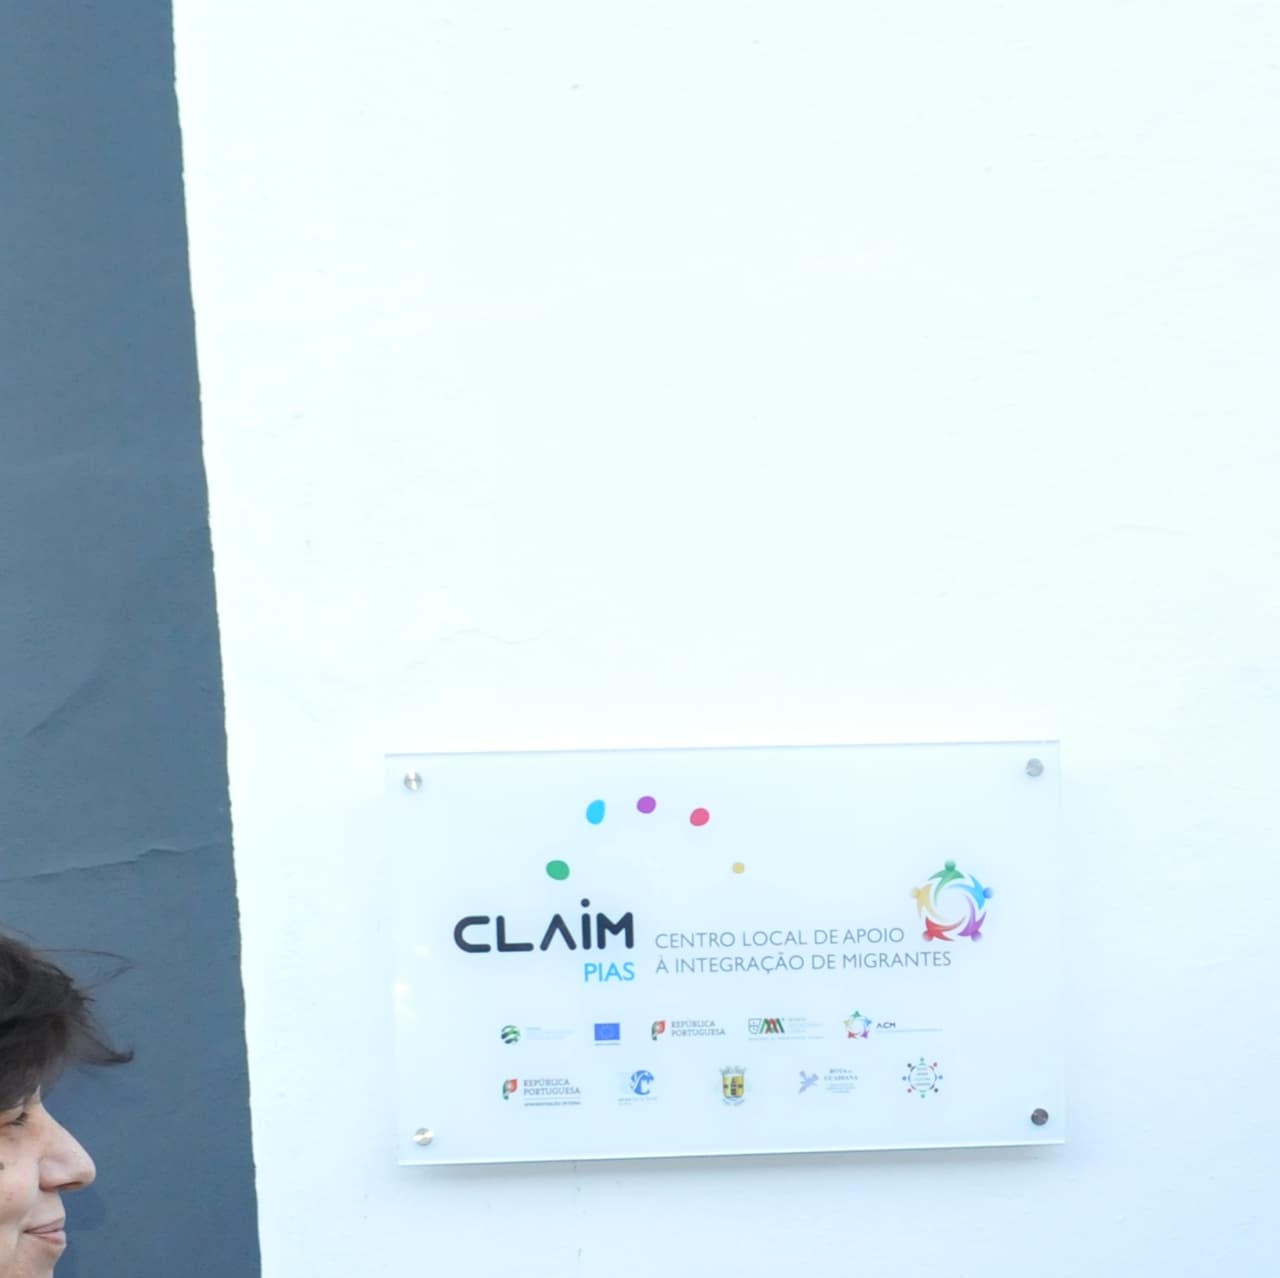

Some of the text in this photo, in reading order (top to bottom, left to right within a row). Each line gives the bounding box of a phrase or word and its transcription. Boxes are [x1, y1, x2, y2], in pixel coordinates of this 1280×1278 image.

[655, 927, 905, 949] CENTRO LOCAL DE APOIO
[583, 961, 635, 983] PIAS
[655, 951, 952, 974] À INTEGRAÇÃO DE MIGRANTES
